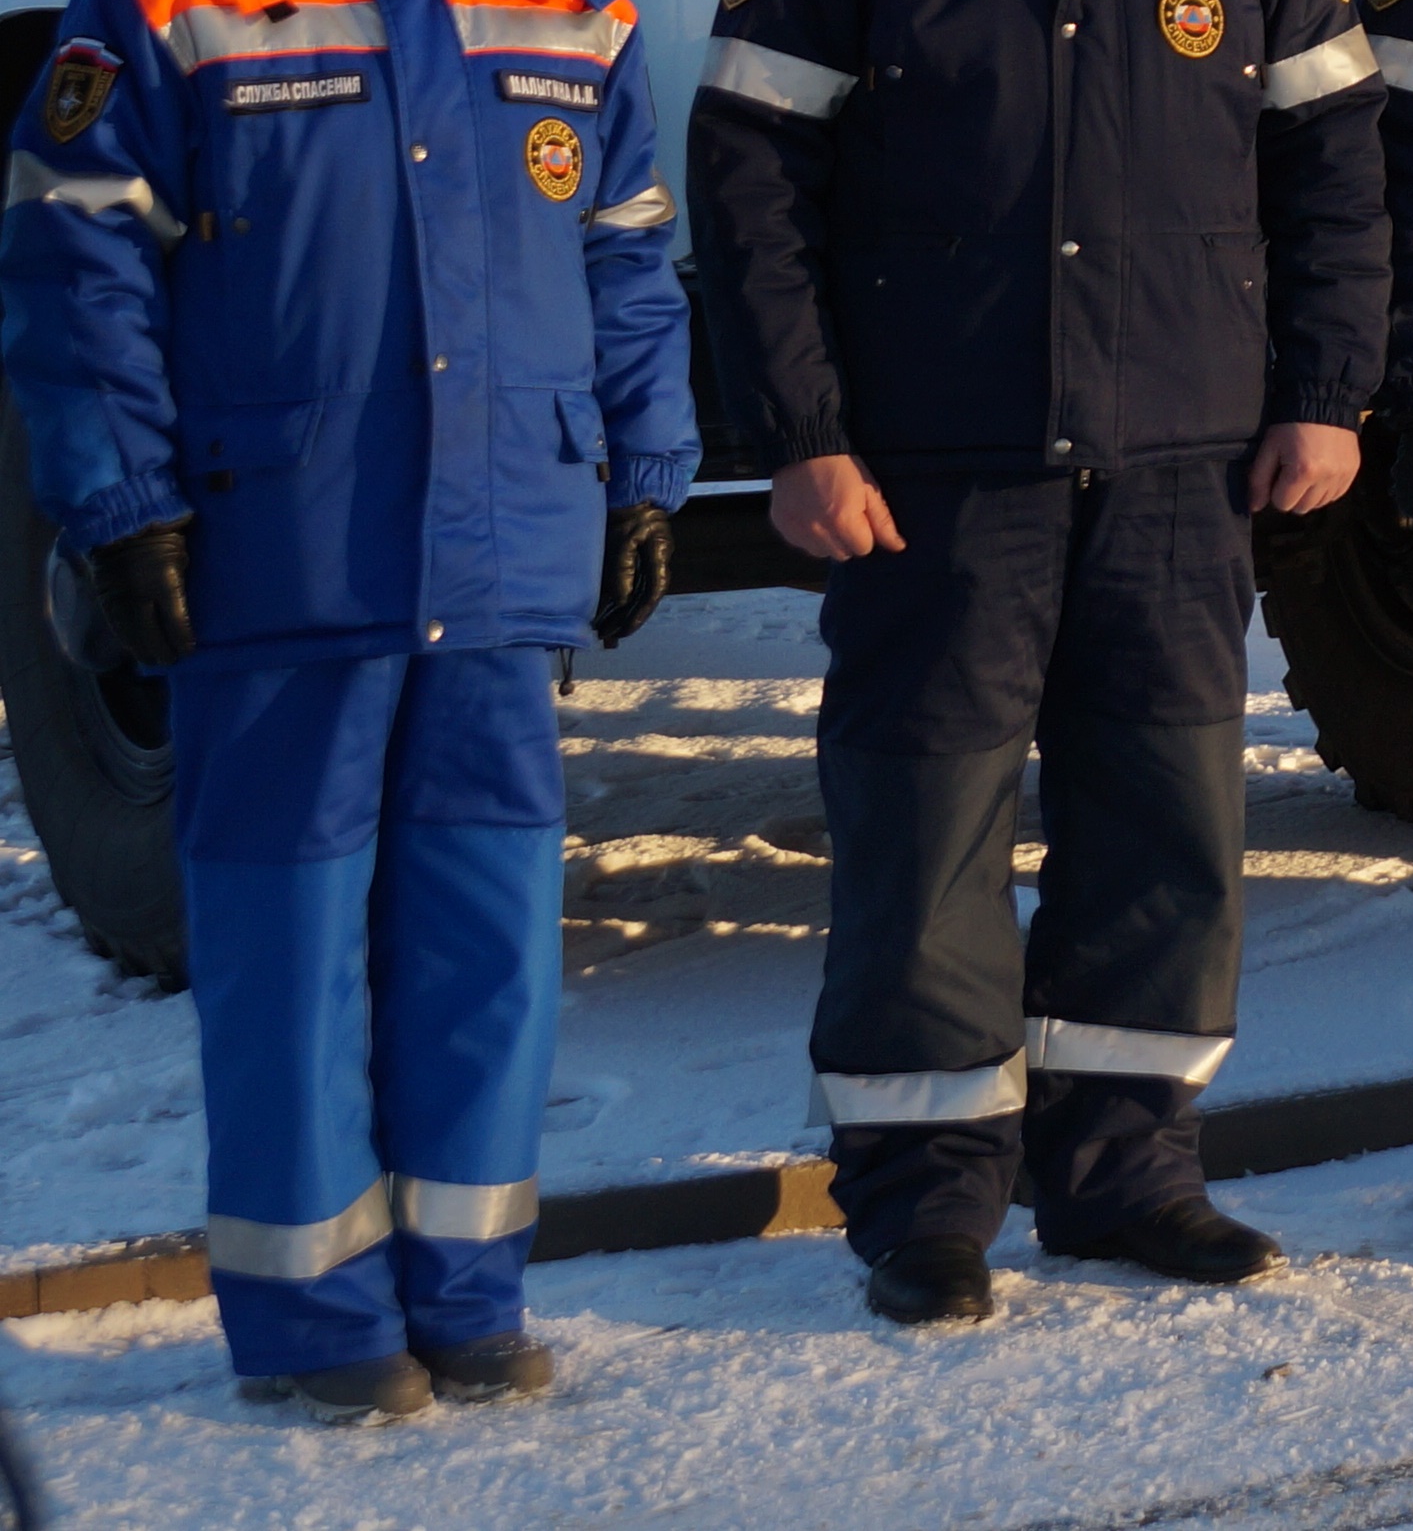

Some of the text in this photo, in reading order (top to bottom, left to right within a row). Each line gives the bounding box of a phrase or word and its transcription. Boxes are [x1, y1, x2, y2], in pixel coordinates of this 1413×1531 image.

[236, 75, 361, 104] СЛУЖБА СПАСЕНИЯ
[509, 74, 572, 102] МАЛЫГИНА
